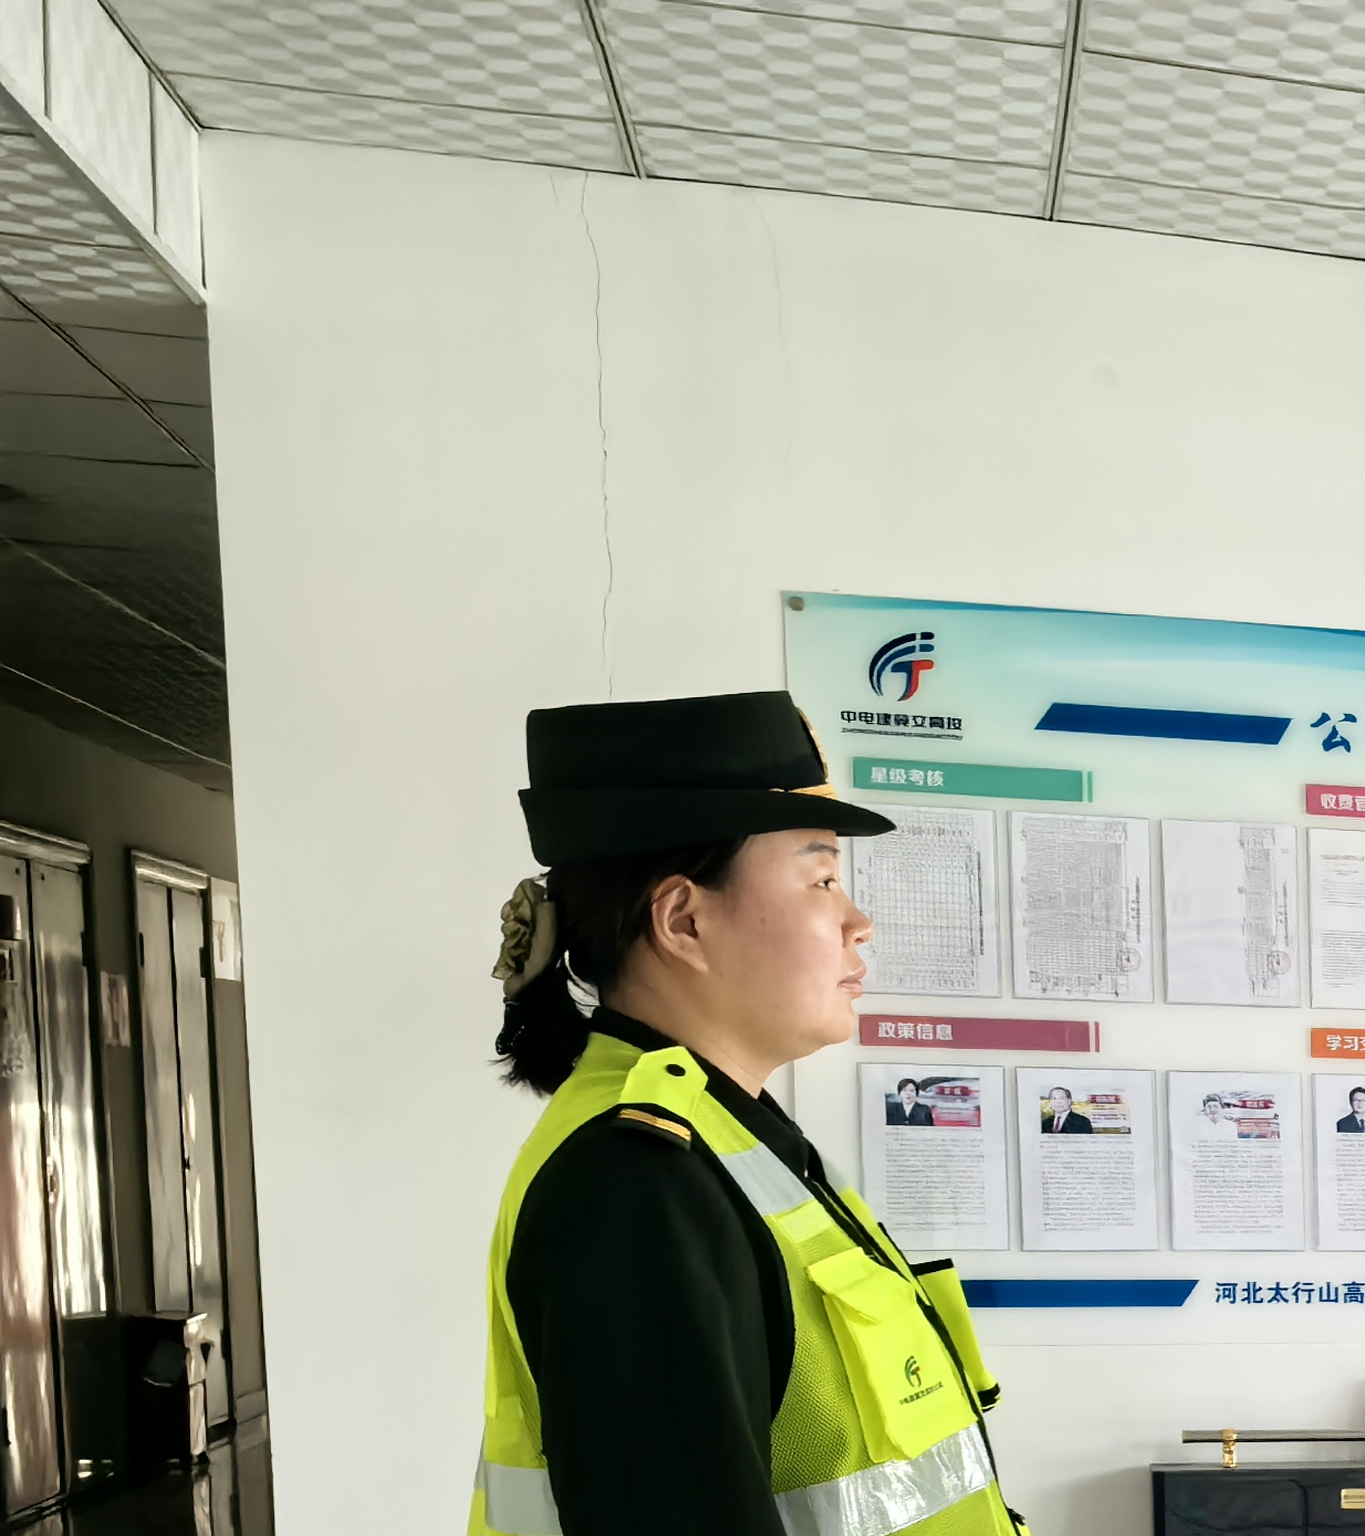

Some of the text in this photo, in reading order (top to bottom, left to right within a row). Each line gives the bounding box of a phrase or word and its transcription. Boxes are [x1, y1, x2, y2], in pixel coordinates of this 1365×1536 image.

[870, 766, 945, 787] 星级考核
[877, 1020, 954, 1042] 政策信息
